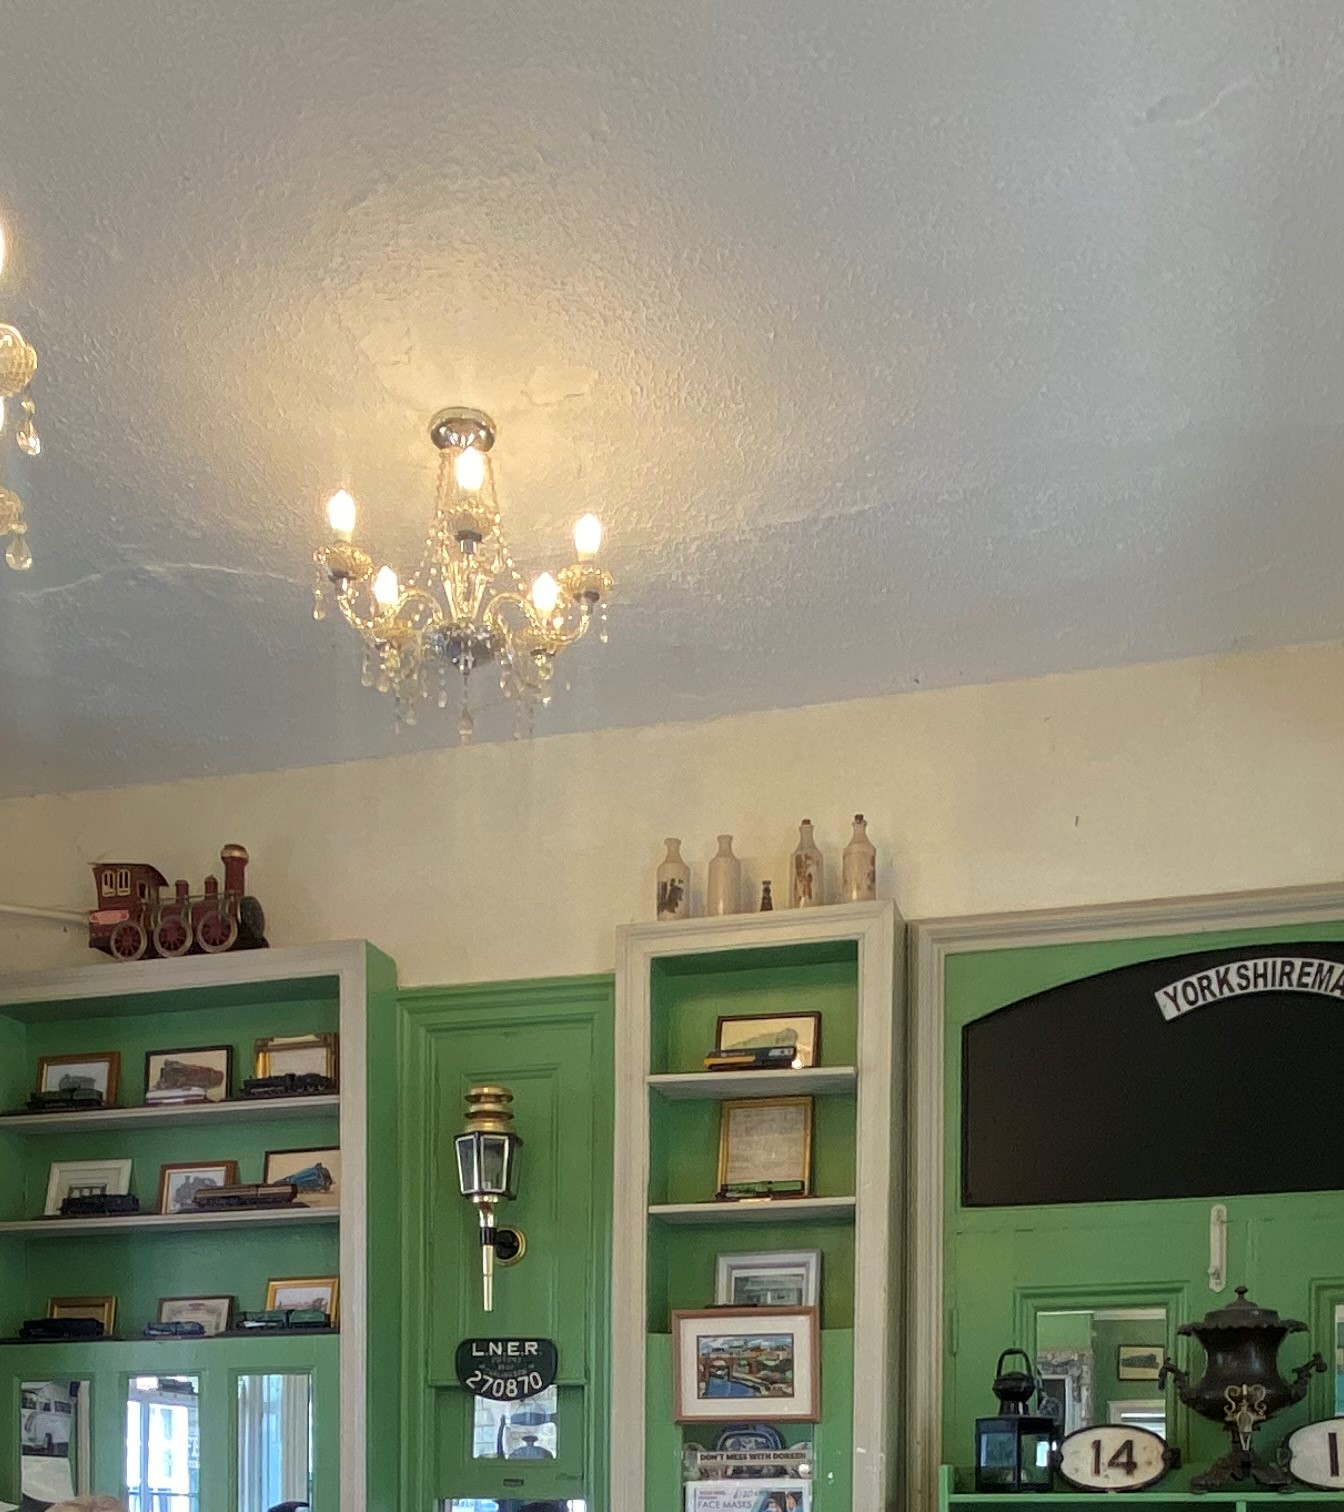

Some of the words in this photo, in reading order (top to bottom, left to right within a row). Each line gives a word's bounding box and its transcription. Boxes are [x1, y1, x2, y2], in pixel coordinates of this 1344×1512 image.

[466, 1370, 543, 1397] 270870
[700, 1453, 725, 1462] DON'T
[726, 1453, 747, 1461] MESS
[749, 1453, 771, 1461] WITH
[1091, 1439, 1138, 1476] 14
[698, 1501, 721, 1509] FACE
[723, 1501, 753, 1509] MASKS
